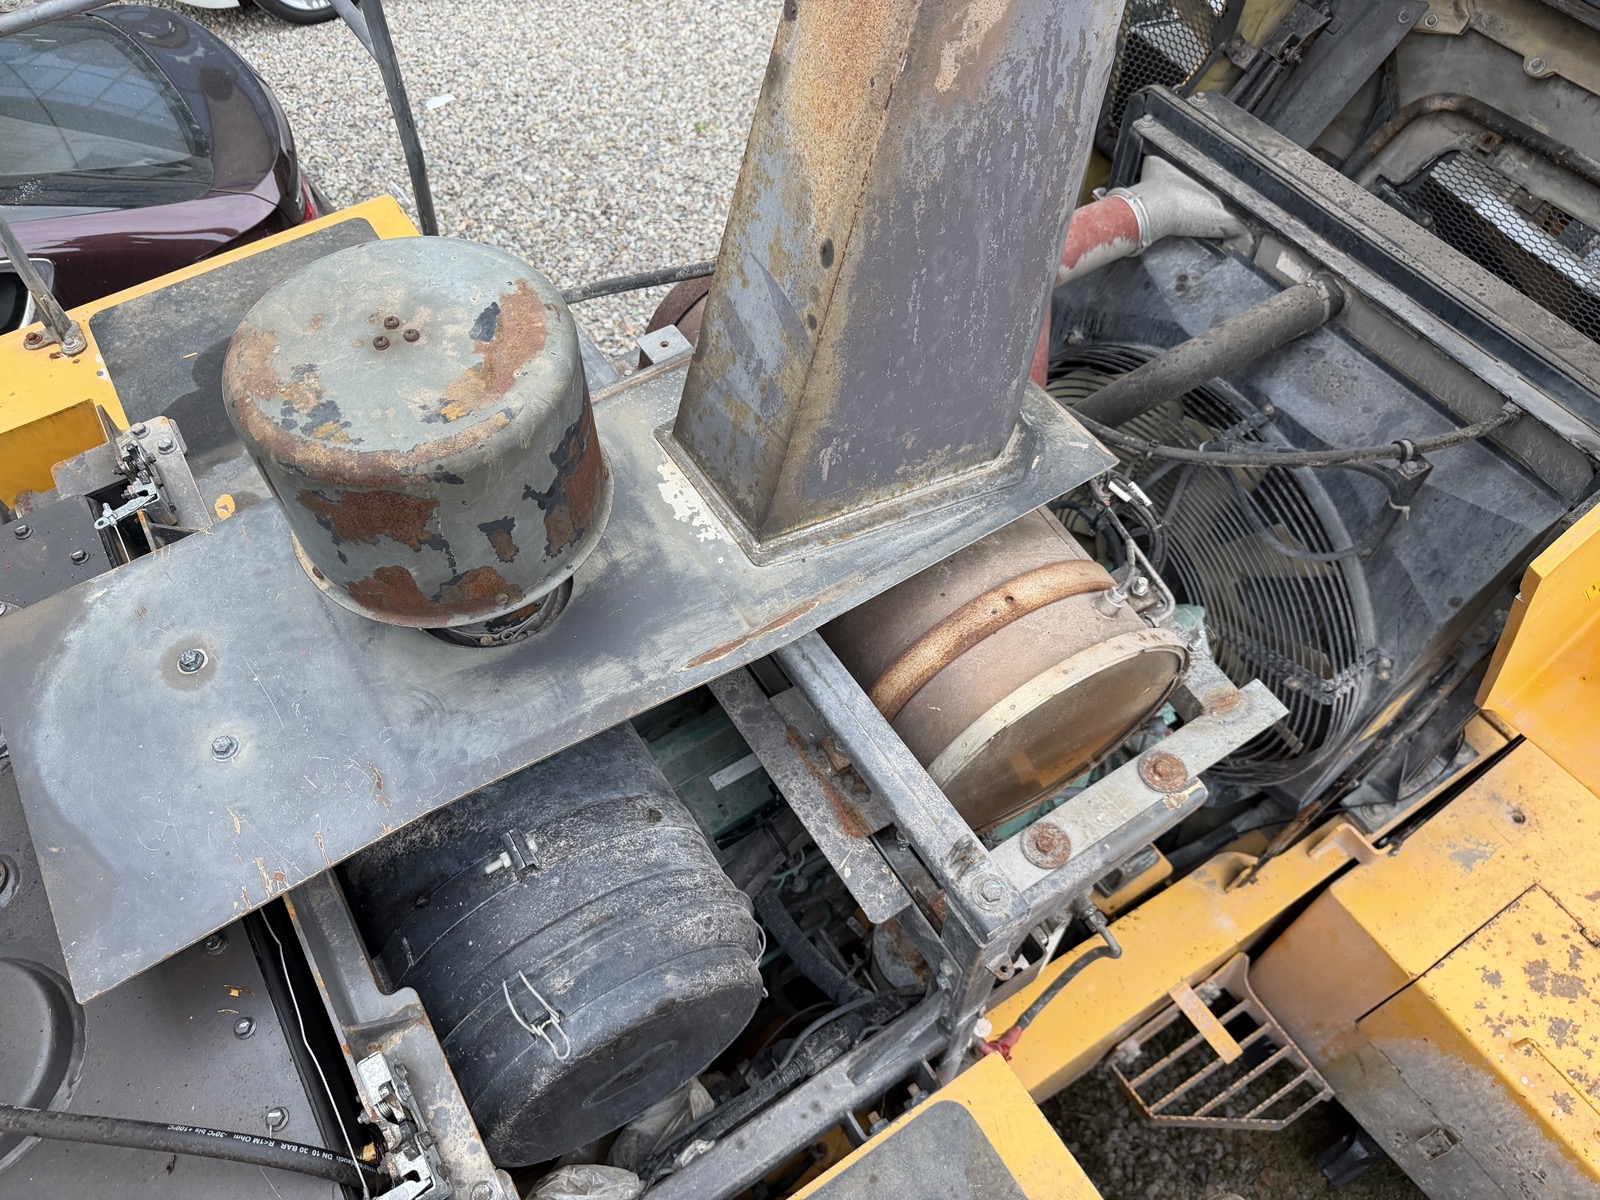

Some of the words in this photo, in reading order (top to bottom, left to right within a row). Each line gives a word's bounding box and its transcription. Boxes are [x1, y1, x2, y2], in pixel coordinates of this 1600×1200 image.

[233, 1134, 252, 1143] Ohm
[280, 1142, 298, 1152] BAR
[299, 1146, 309, 1154] 30
[312, 1149, 321, 1157] 10
[322, 1152, 333, 1161] DN
